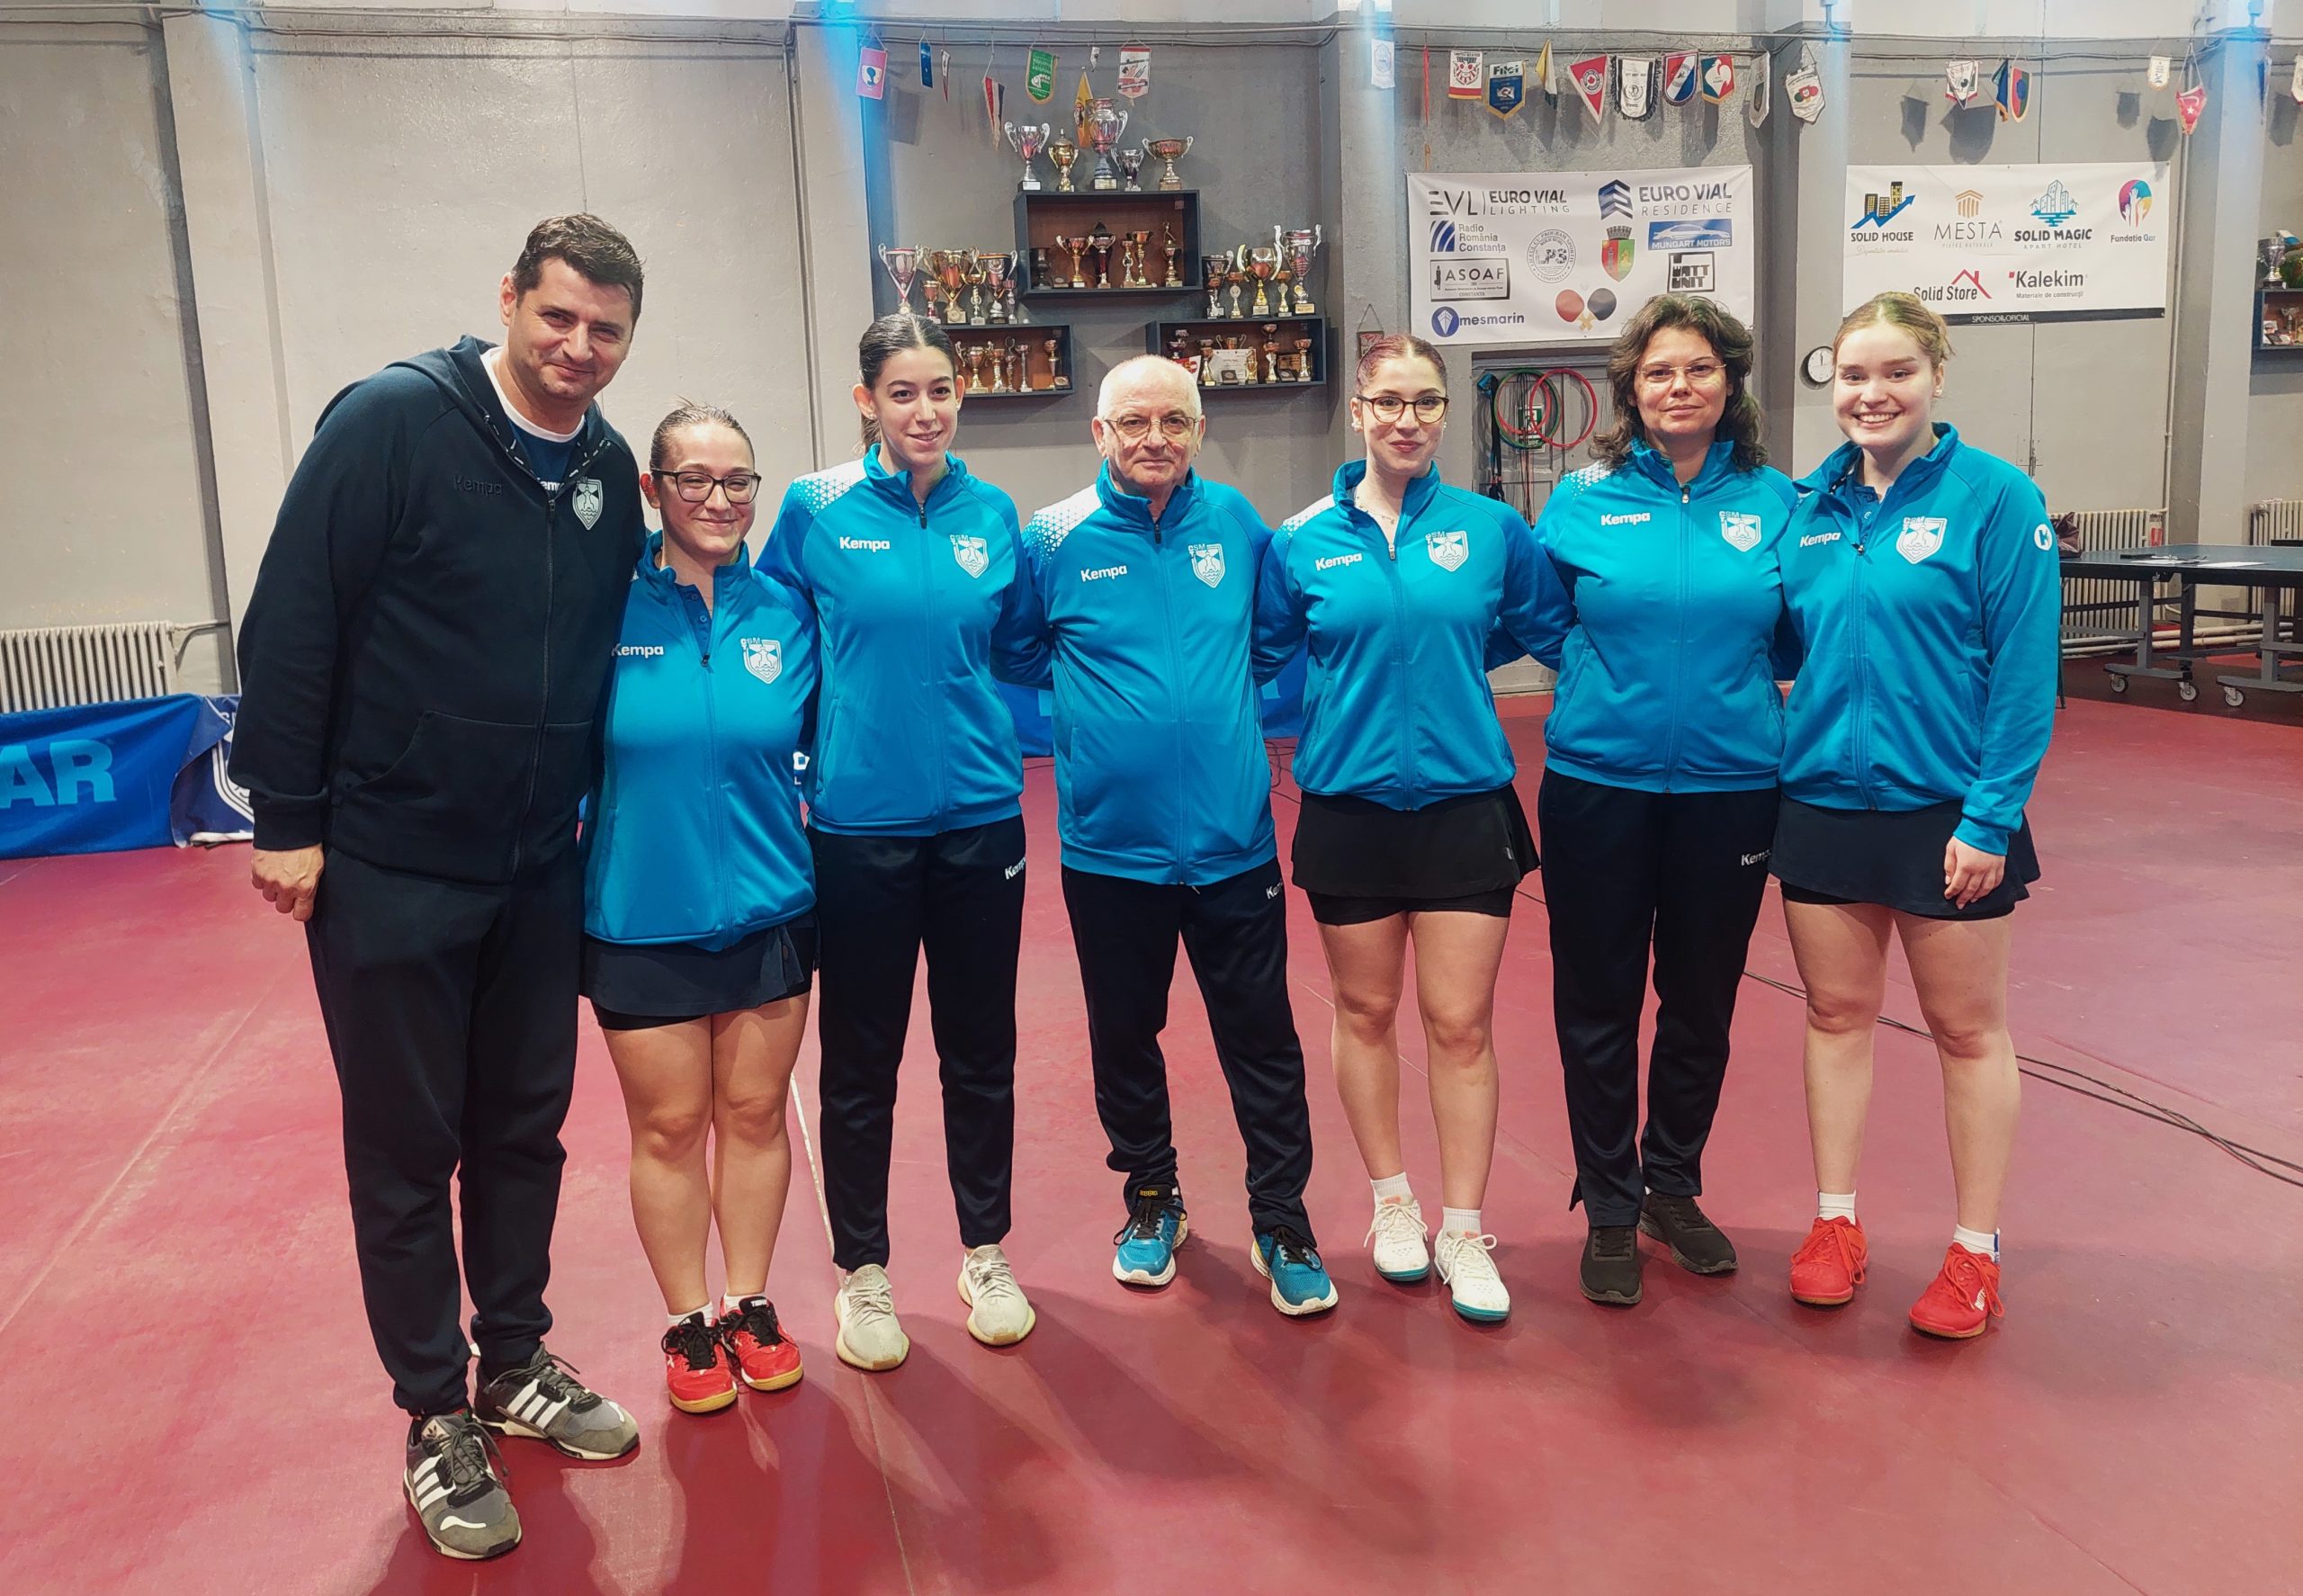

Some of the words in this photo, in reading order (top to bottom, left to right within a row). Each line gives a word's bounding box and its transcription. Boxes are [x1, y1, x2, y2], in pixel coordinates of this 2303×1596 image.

[1489, 190, 1530, 203] EURO
[1534, 189, 1567, 203] VIAL
[1639, 185, 1690, 202] EURO
[1693, 183, 1733, 201] VIAL
[1490, 205, 1570, 216] LIGHTING
[1642, 202, 1733, 217] RESIDENCE
[1458, 224, 1484, 232] Radio
[1934, 222, 2003, 240] MESTA
[1459, 233, 1498, 242] România
[1850, 232, 1878, 242] SOLID
[1882, 231, 1914, 242] HOUSE
[2014, 229, 2050, 242] SOLID
[2054, 229, 2092, 240] MAGIC
[1652, 239, 1695, 249] MUNGART
[1697, 238, 1731, 247] MOTORS
[1445, 268, 1504, 281] ASOAF
[2016, 270, 2083, 288] Kalekim
[1913, 286, 1943, 301] Solid
[1946, 285, 1977, 300] Store
[1460, 312, 1524, 326] mesmarin
[1600, 512, 1651, 526] Kempa
[838, 536, 891, 553] Kempa
[1799, 532, 1842, 547] Kempa
[1314, 552, 1363, 571] Kempa
[1080, 565, 1128, 583] Kempa
[611, 643, 664, 659] Kempa
